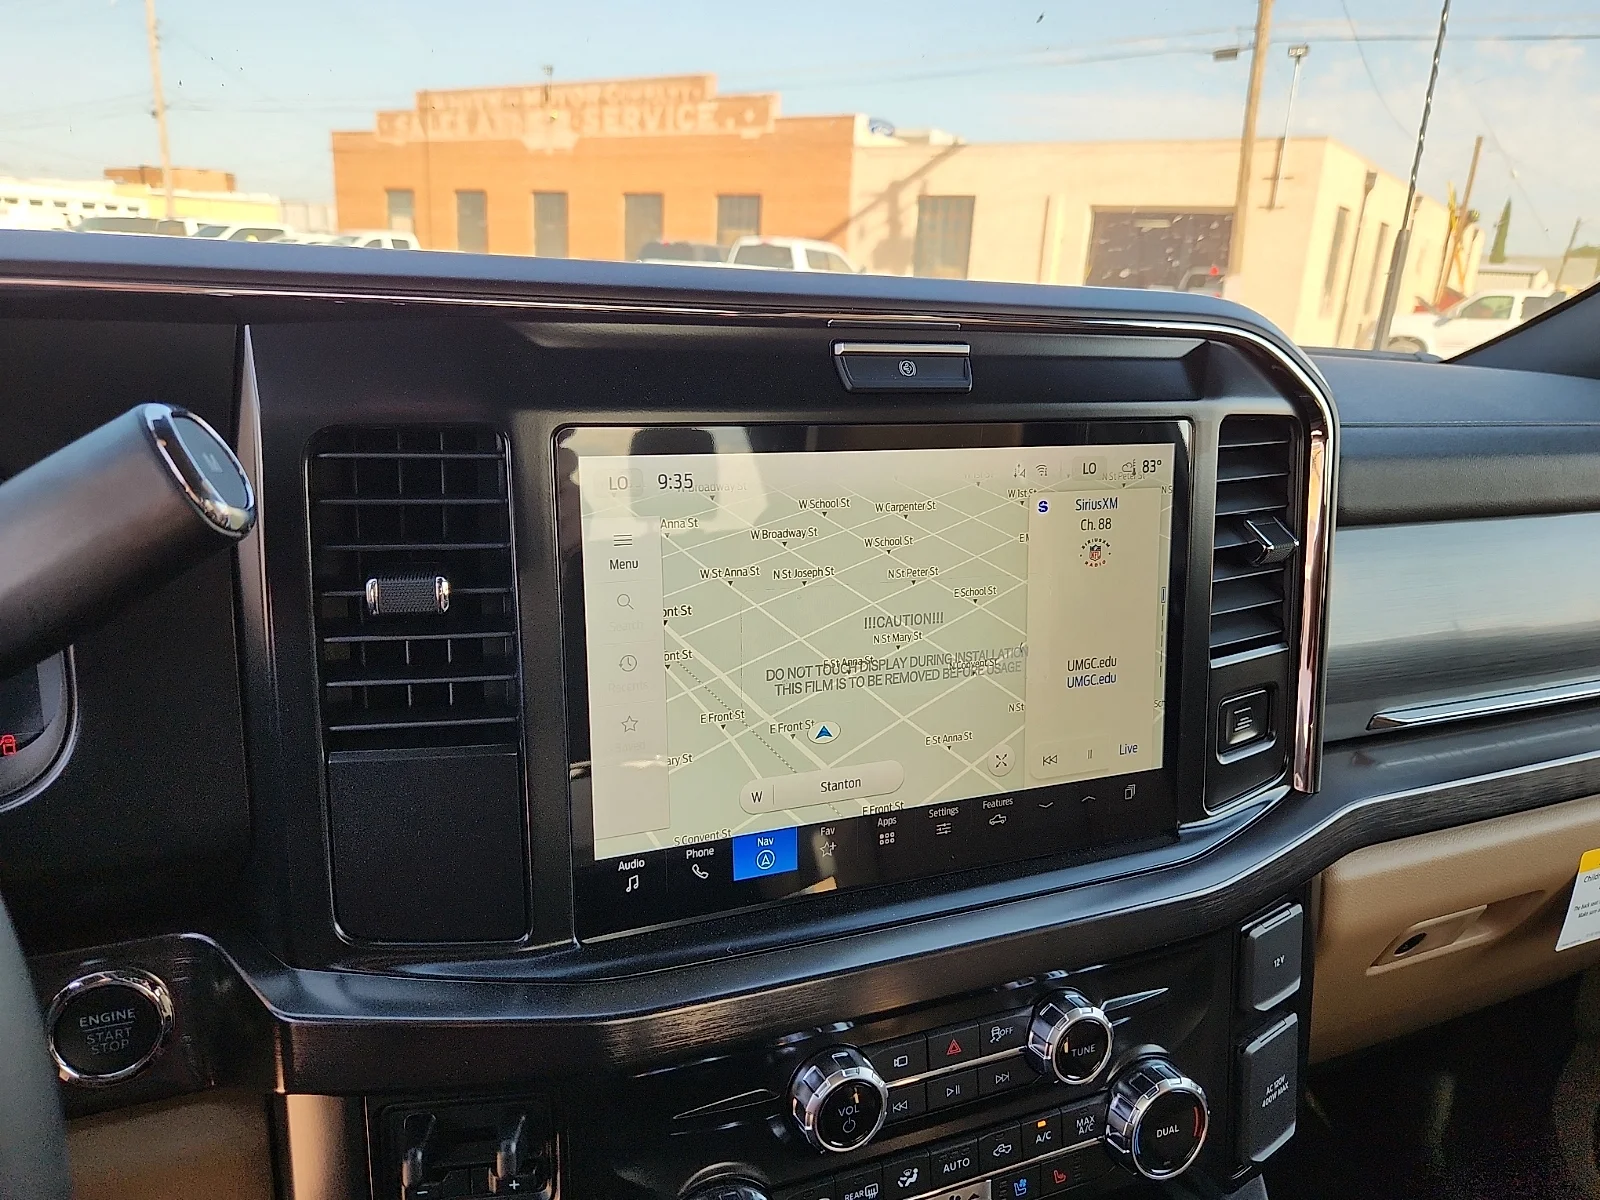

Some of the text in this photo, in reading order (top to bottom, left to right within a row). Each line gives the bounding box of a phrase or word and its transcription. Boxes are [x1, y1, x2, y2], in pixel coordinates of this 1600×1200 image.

[1082, 462, 1097, 475] LO
[608, 475, 629, 491] LO
[657, 473, 694, 490] 9:35
[798, 497, 850, 510] W School St
[875, 500, 936, 513] W Carpenter St
[1075, 497, 1118, 511] SiriusXM
[661, 517, 699, 529] Anna St
[1080, 517, 1112, 531] Ch. 88
[751, 527, 818, 541] W Broadway St
[864, 535, 914, 548] W School St
[609, 558, 639, 571] Menu
[700, 566, 760, 579] W St Anna St
[773, 566, 835, 580] N St Joseph St
[888, 566, 939, 579] N St Peter St
[954, 585, 997, 598] E School St
[680, 605, 692, 616] St
[873, 631, 923, 644] N St Mary St
[681, 650, 693, 660] St
[864, 655, 874, 665] St
[766, 646, 1029, 682] DO NOT TOUCH DISPLAY DURING INSTALLATION
[1067, 656, 1117, 672] UMGC.edu
[774, 661, 1022, 697] THIS FILM IS TO BE REMOVED BEFORE USAGE
[1066, 673, 1117, 689] UMGC.edu
[1008, 703, 1015, 712] N
[701, 709, 745, 724] E Front St
[770, 724, 776, 734] E
[777, 721, 802, 733] Front
[925, 731, 973, 746] E St Anna St
[1119, 743, 1138, 756] Live
[682, 754, 693, 764] St
[820, 777, 861, 792] Stanton
[751, 791, 763, 802] W
[982, 797, 1013, 809] Features
[870, 802, 893, 814] Front
[894, 801, 905, 811] St
[928, 805, 960, 818] Settings
[877, 816, 897, 828] Apps
[681, 831, 719, 845] Convent
[720, 828, 732, 839] St
[820, 826, 836, 836] Fav
[757, 837, 774, 847] Nav
[686, 847, 715, 859] Phone
[618, 858, 645, 871] Audio
[1273, 954, 1285, 968] 12V
[79, 1008, 136, 1028] ENGINE
[86, 1027, 132, 1046] START
[999, 1026, 1014, 1037] OFF
[91, 1039, 129, 1055] STOP
[1071, 1044, 1096, 1058] TUNE
[838, 1104, 860, 1117] VOL
[1076, 1114, 1096, 1128] MAX
[1078, 1124, 1095, 1136] A/C
[1156, 1124, 1180, 1138] DUAL
[1035, 1130, 1052, 1144] A/C
[942, 1157, 971, 1174] AUTO
[843, 1189, 865, 1200] REAR
